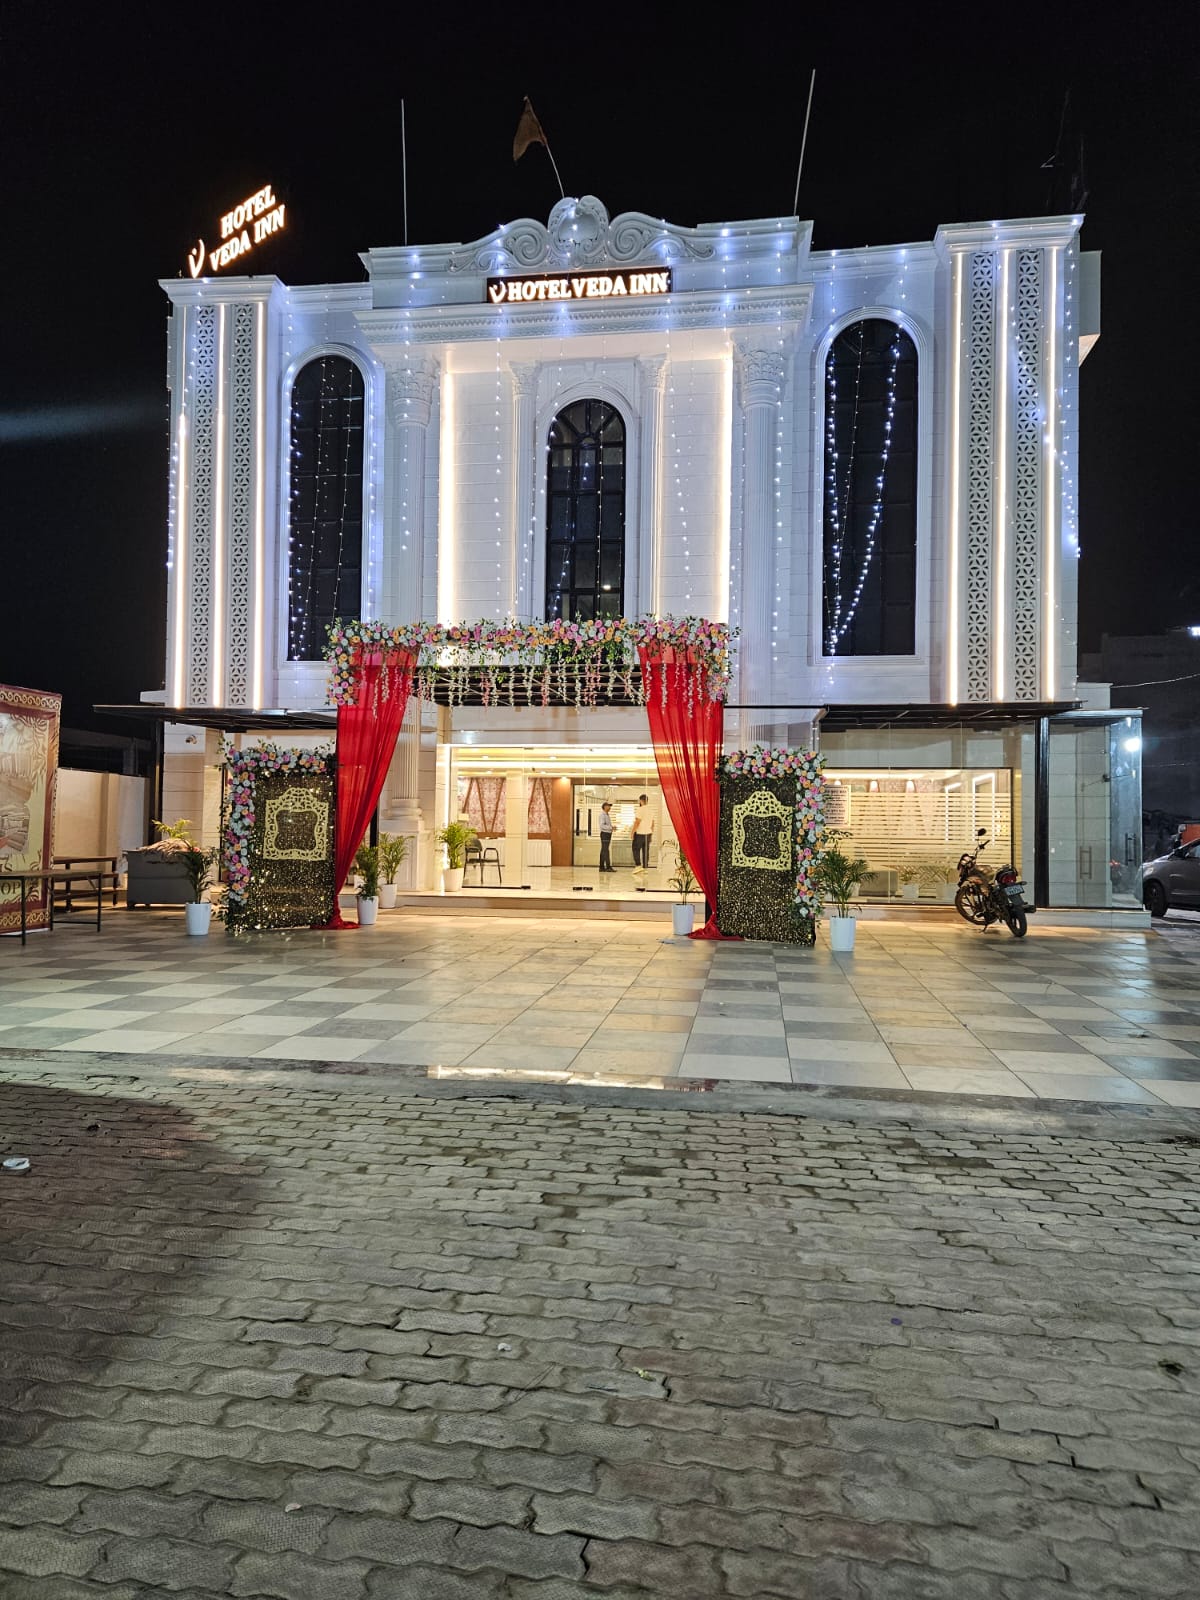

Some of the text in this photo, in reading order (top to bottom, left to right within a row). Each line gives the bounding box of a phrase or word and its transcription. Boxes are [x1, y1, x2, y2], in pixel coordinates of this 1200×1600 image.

[209, 204, 285, 271] VEDA INN
[221, 184, 276, 239] HOTEL
[507, 278, 572, 301] HOTEL
[571, 275, 627, 298] VEDA
[629, 272, 669, 294] INN
